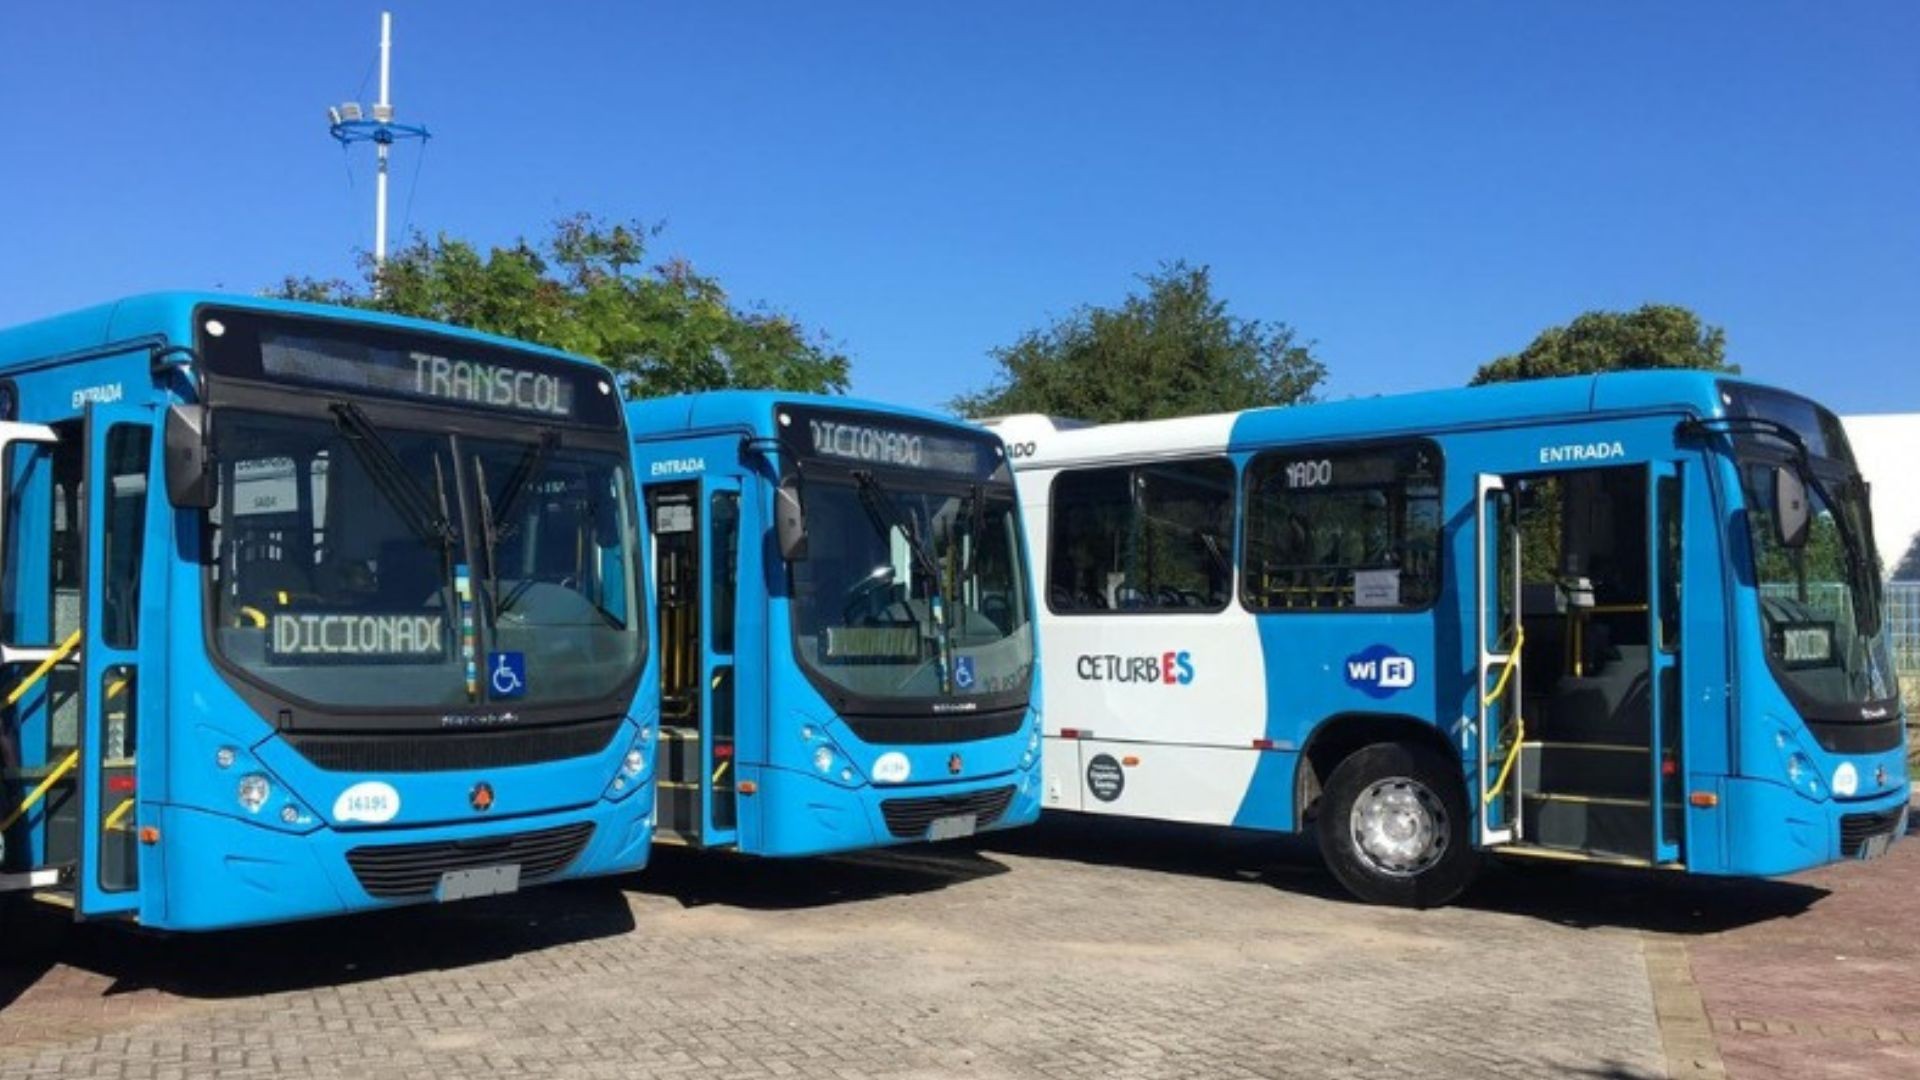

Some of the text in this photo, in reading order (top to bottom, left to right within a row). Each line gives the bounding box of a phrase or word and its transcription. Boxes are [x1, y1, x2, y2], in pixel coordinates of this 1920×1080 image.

[409, 352, 569, 414] TRANSCOL
[72, 382, 122, 409] ENTRADA
[1540, 442, 1624, 463] ENTRADA
[651, 457, 706, 475] ENTRADA
